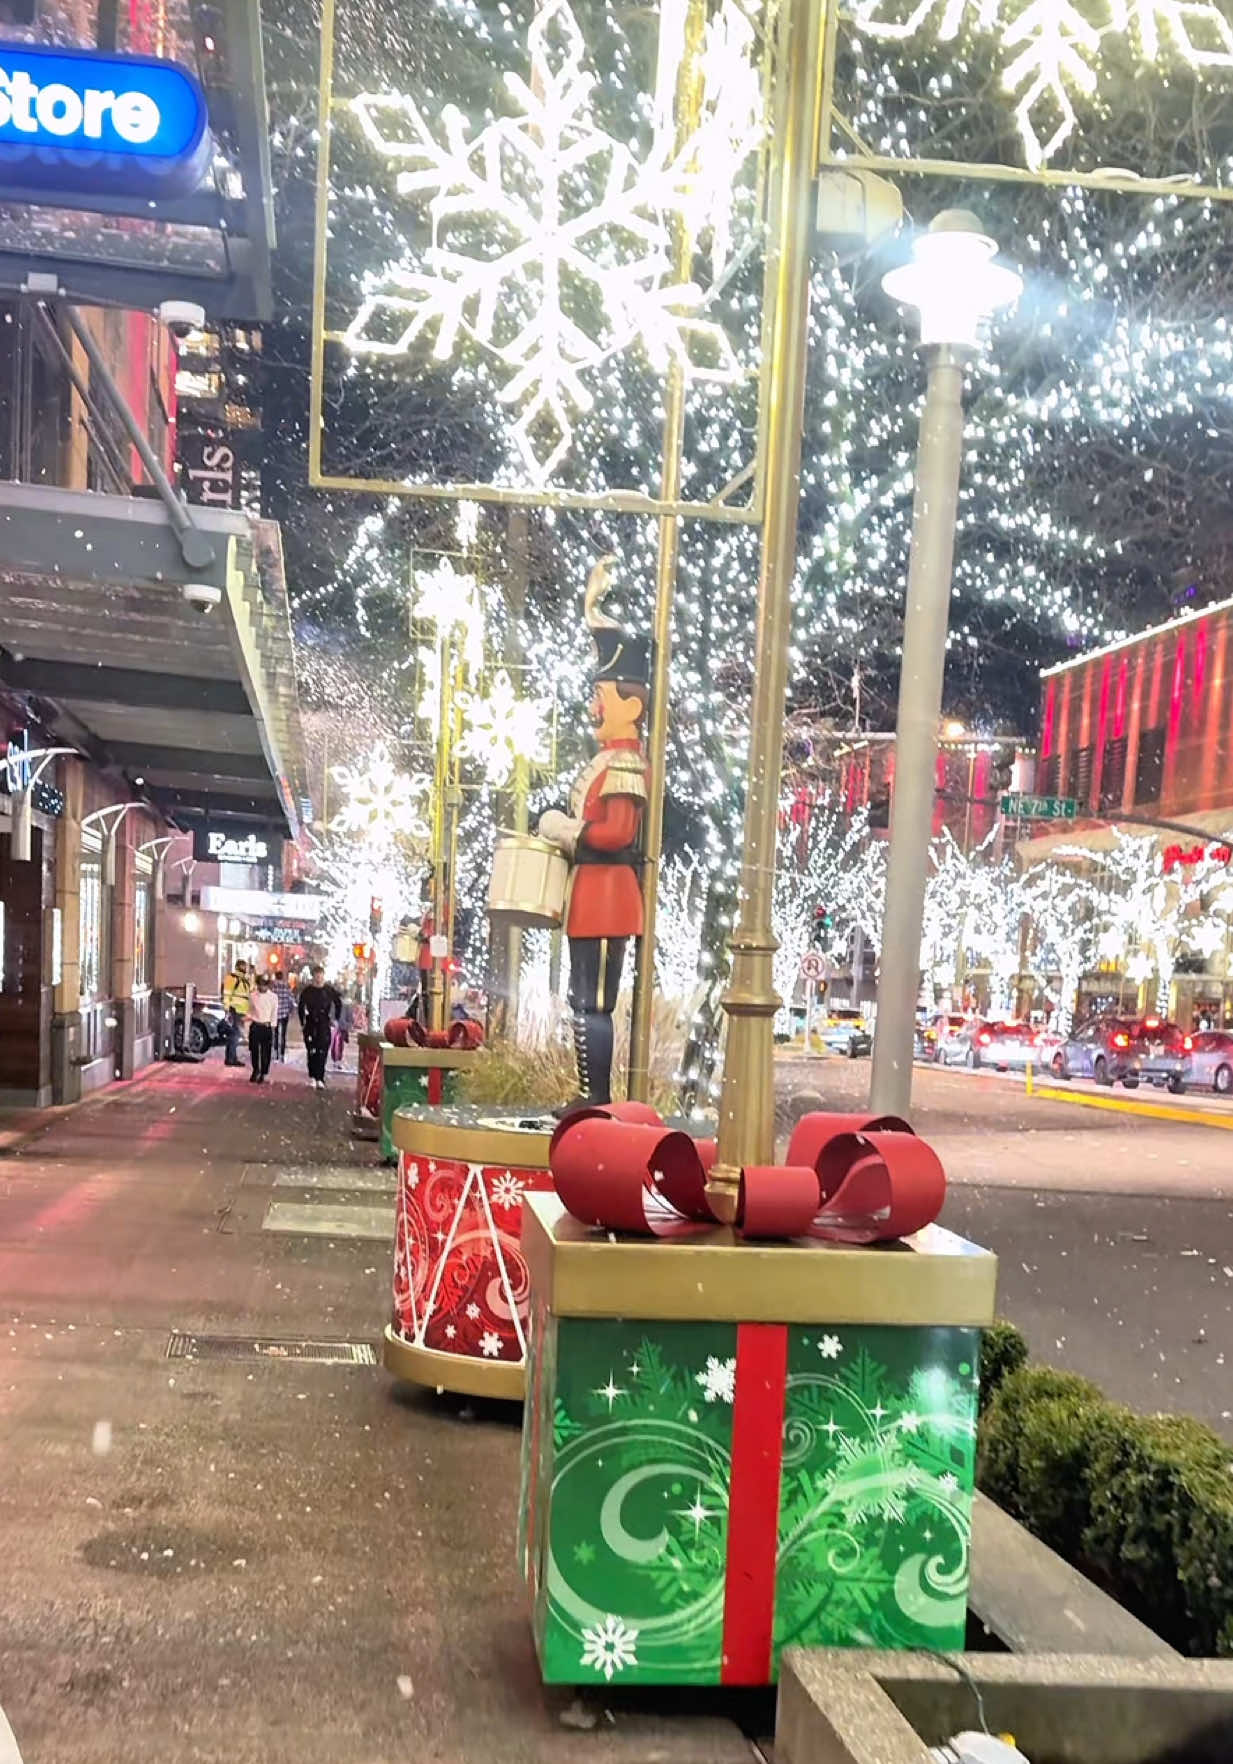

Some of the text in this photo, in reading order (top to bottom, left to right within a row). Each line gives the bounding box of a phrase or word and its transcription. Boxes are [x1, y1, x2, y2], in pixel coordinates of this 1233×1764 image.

[0, 66, 160, 143] tore
[1008, 797, 1025, 814] NE
[1052, 801, 1066, 816] St
